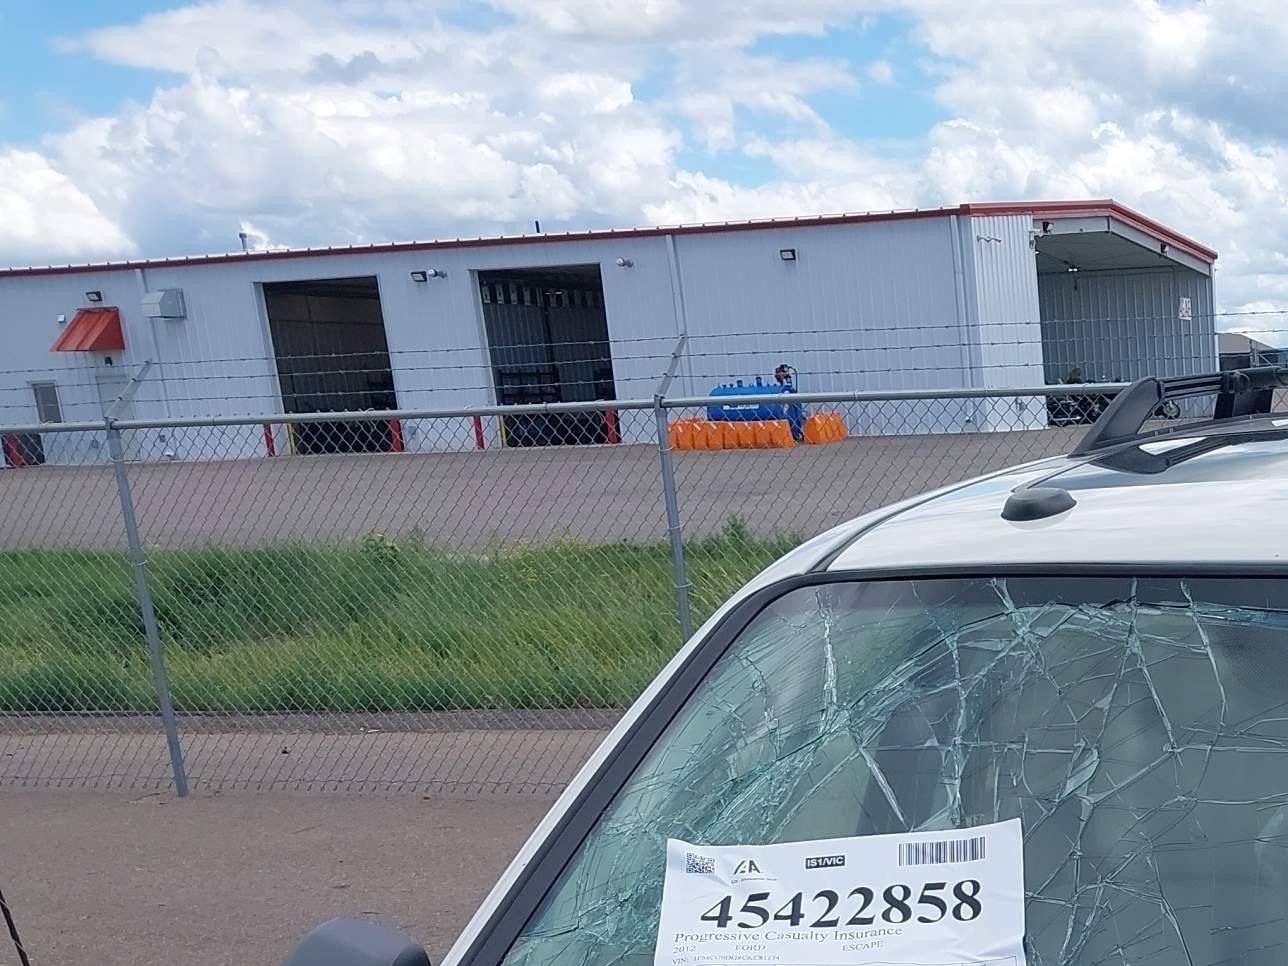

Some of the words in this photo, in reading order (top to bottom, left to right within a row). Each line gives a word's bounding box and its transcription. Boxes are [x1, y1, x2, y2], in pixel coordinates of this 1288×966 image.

[807, 856, 844, 868] IS1/VIC
[700, 879, 983, 928] 45422858
[674, 930, 760, 943] Progressive
[764, 930, 829, 943] Casualty
[833, 927, 903, 941] Insurance
[672, 944, 697, 953] 2012
[842, 940, 884, 952] ESCAPE
